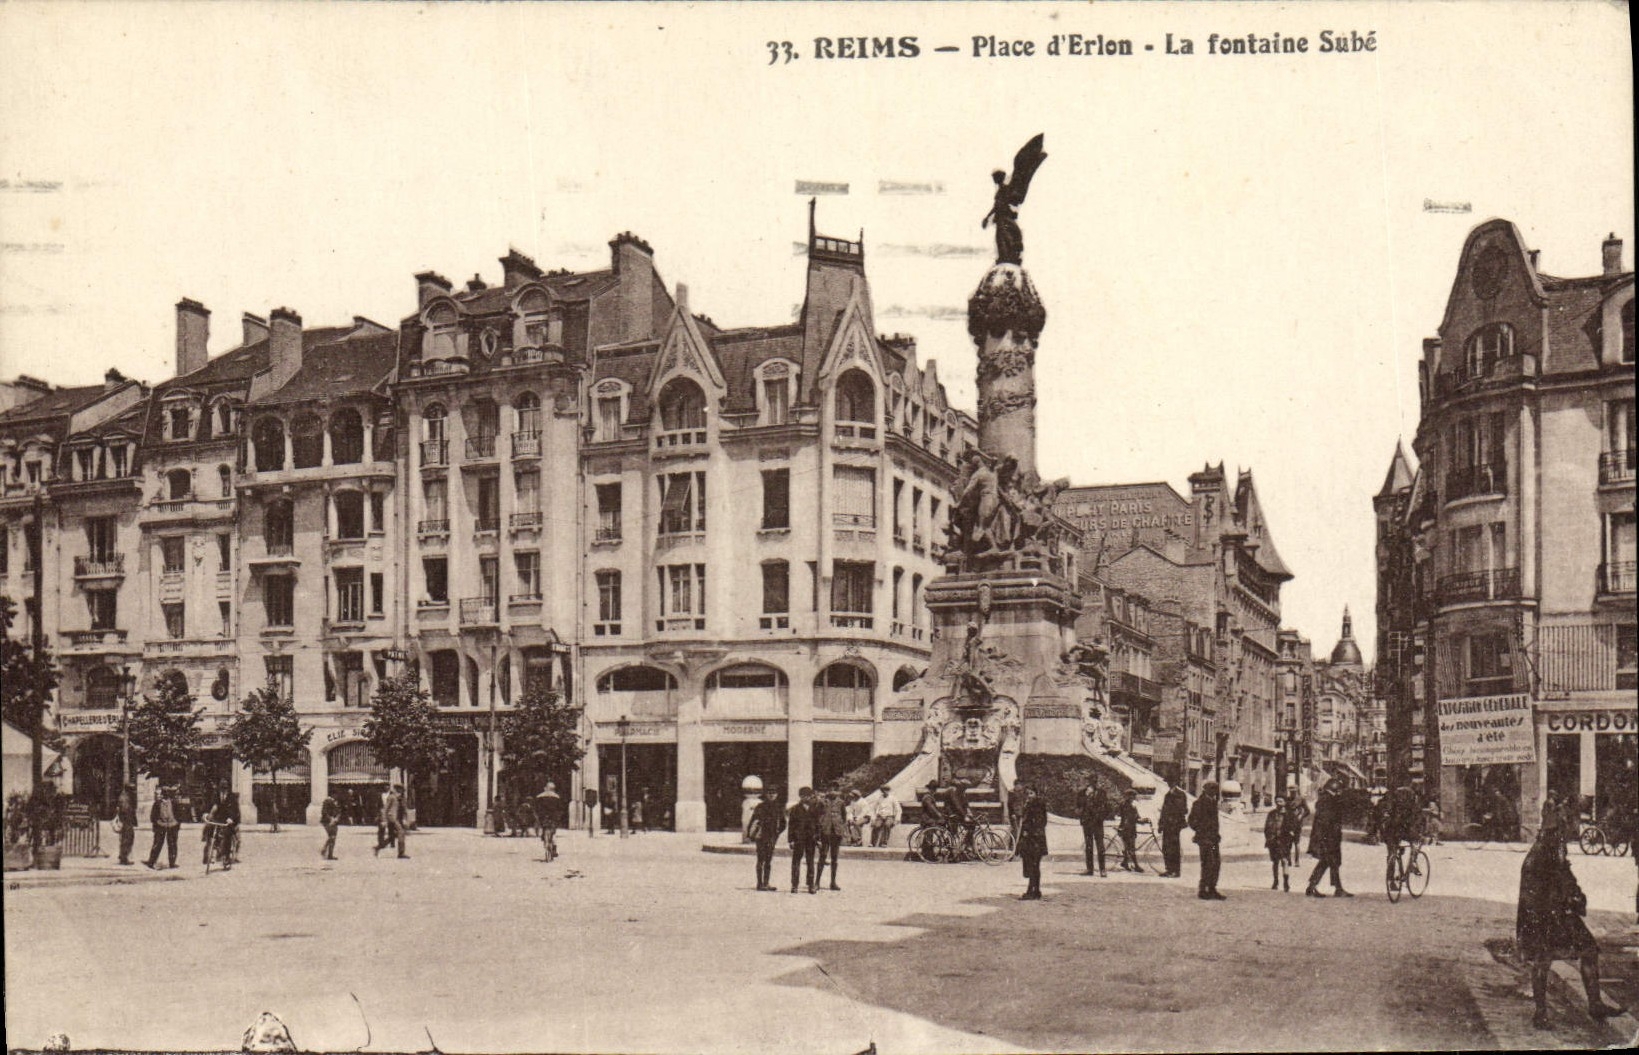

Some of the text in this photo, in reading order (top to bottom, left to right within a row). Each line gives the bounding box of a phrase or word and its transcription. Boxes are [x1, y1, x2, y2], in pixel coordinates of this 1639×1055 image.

[1111, 499, 1152, 515] PARIS
[1112, 518, 1127, 530] DE
[723, 725, 766, 735] MODERNE
